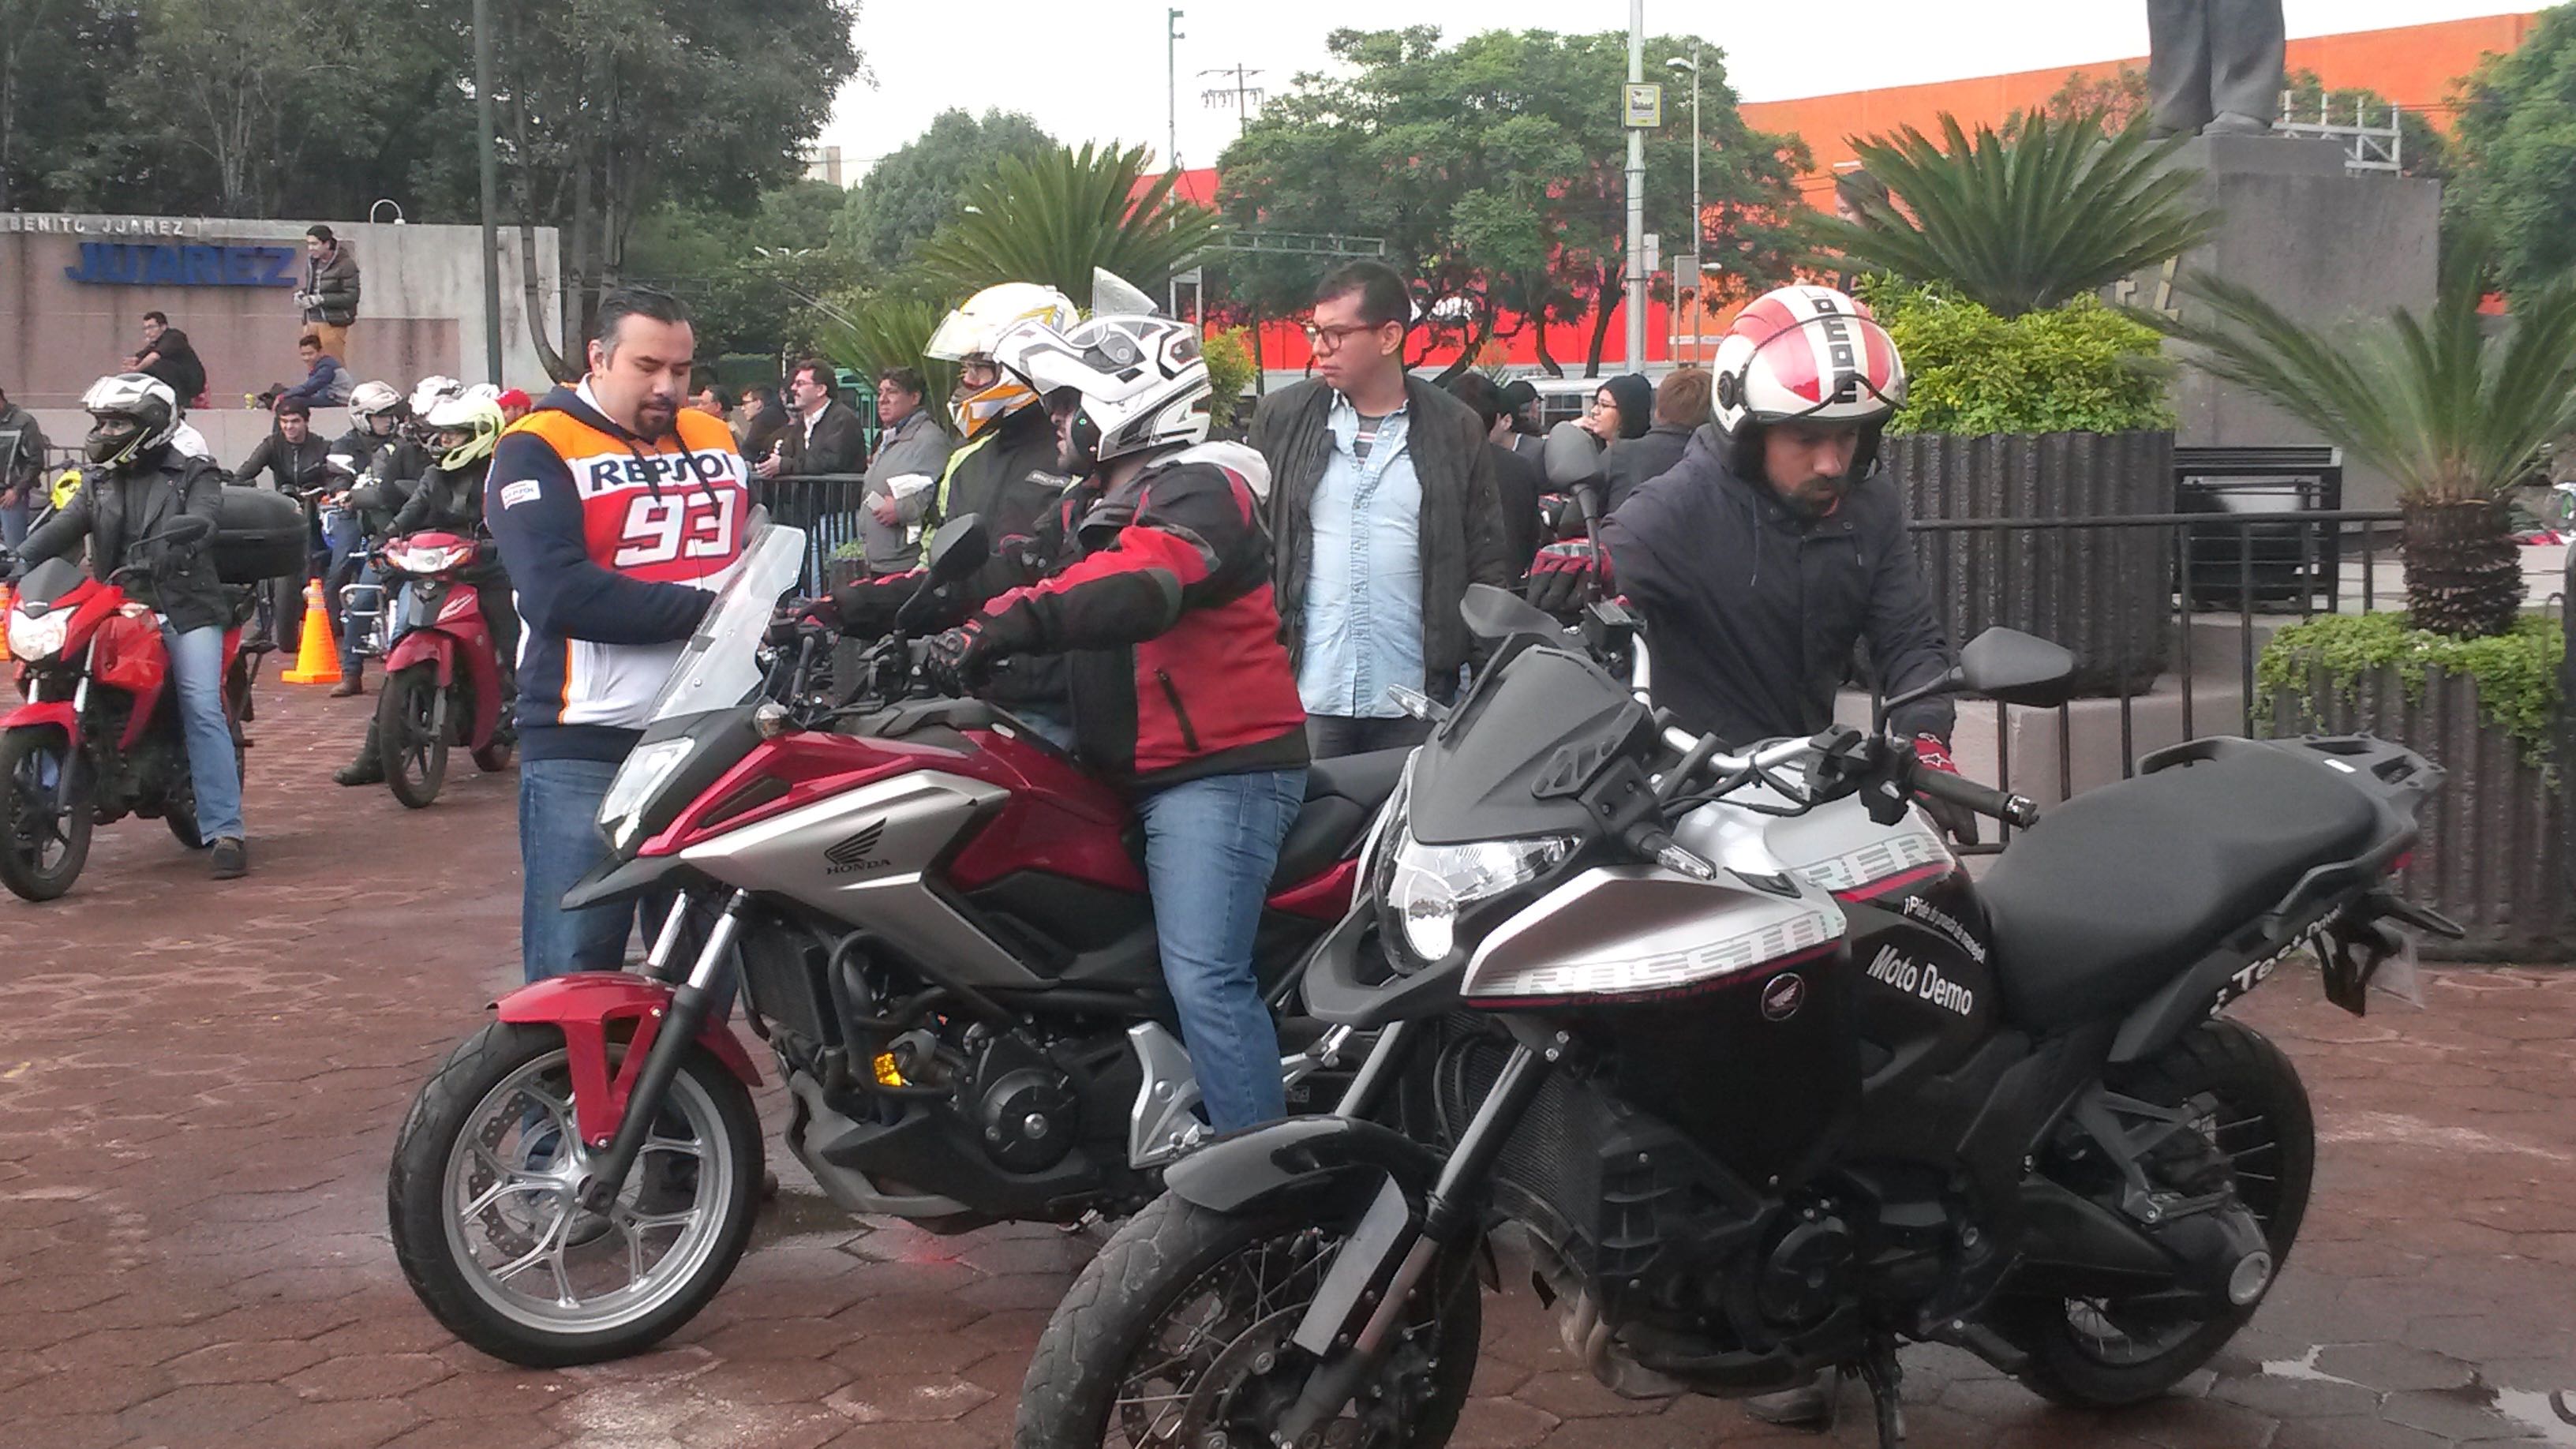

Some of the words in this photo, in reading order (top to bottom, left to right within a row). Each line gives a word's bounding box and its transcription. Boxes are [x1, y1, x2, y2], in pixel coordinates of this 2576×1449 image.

[64, 242, 298, 287] JUAREZ
[613, 487, 737, 568] 93
[826, 859, 891, 875] HONDA
[1866, 943, 1919, 993] Moto
[1919, 962, 1974, 1017] Demo
